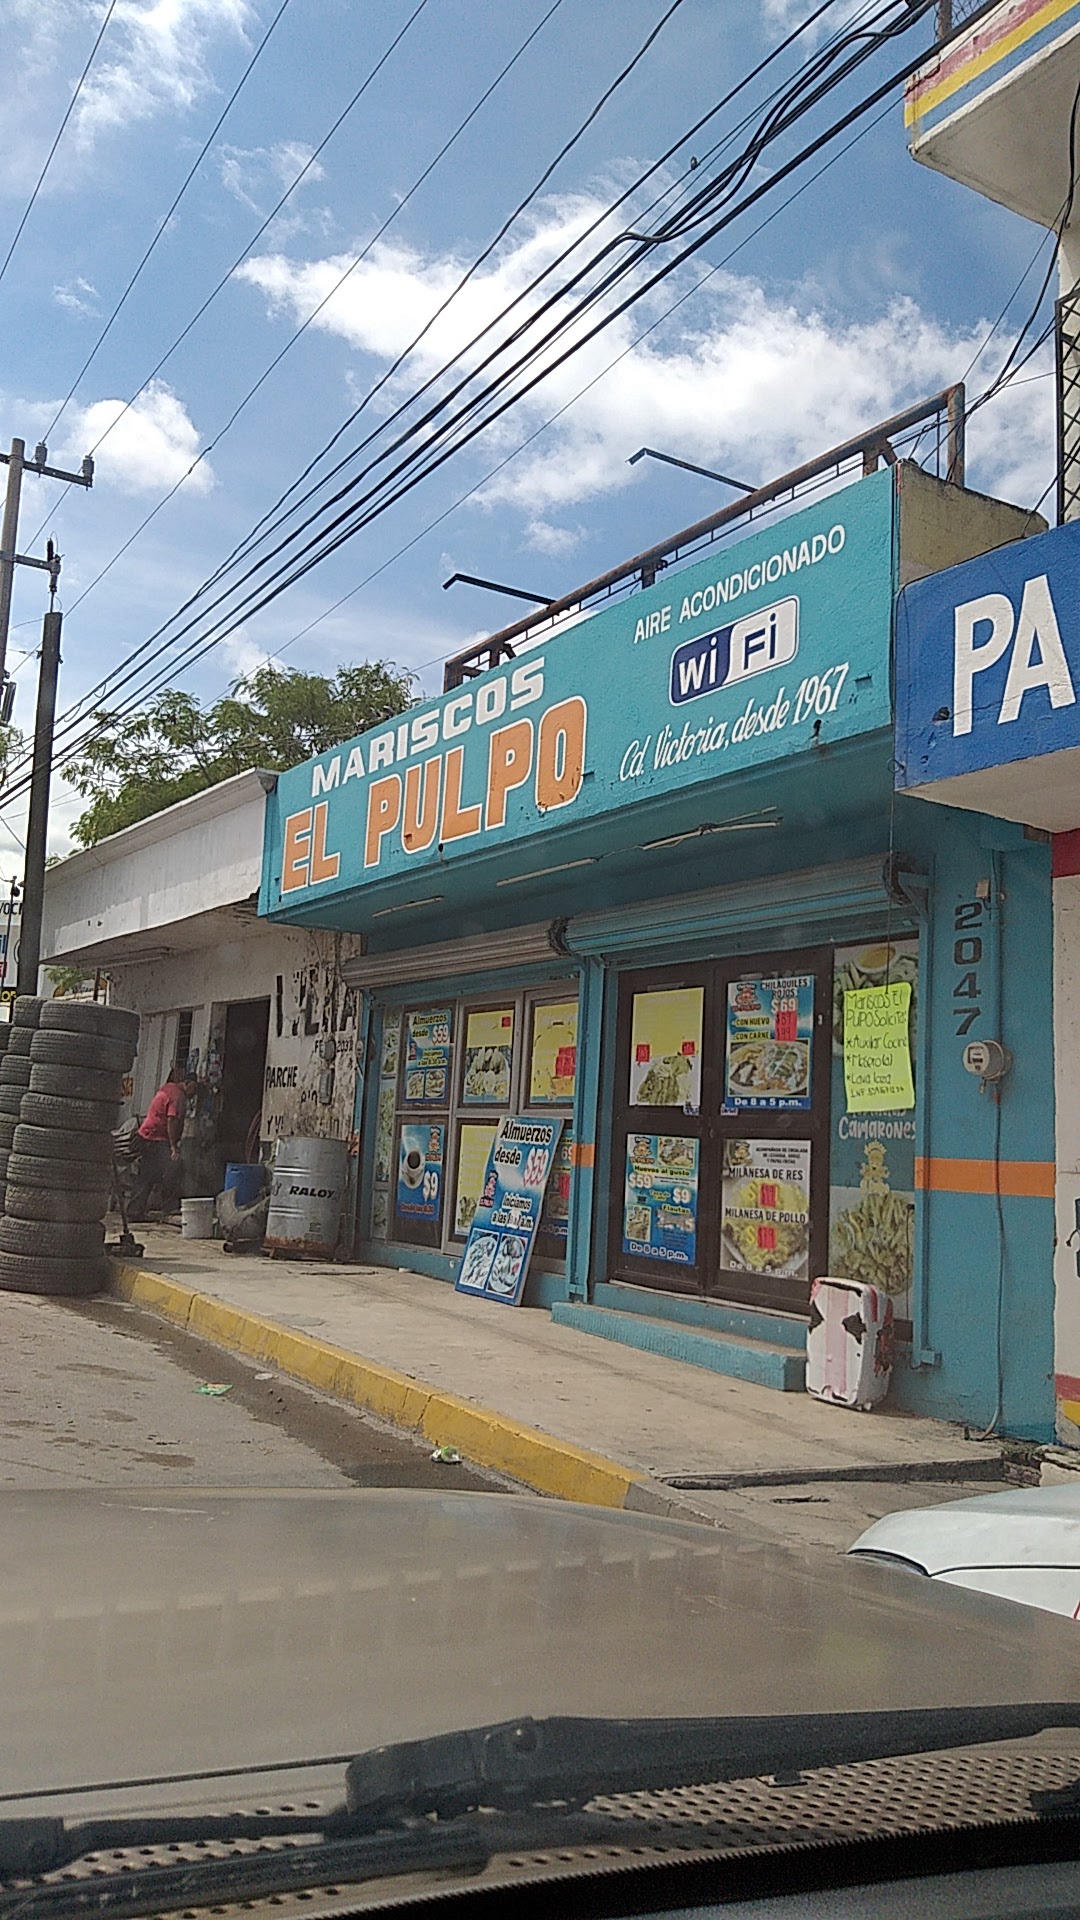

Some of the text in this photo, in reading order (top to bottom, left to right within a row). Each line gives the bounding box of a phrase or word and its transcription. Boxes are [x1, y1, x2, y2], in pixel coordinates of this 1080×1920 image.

[633, 524, 847, 644] AIRE ACONDICIONADO
[953, 574, 1076, 738] PA
[311, 656, 545, 797] MARISCOS
[619, 735, 652, 782] Cd.
[731, 686, 792, 744] desde
[792, 662, 850, 726] 1967
[281, 695, 588, 895] EL PULPO
[952, 902, 983, 1037] 2047
[760, 978, 808, 990] CHILAQUILES
[412, 1013, 447, 1026] Almuerzos
[411, 1028, 429, 1038] desde
[265, 1065, 299, 1093] PARCHE
[734, 1097, 748, 1106] De
[750, 1097, 757, 1106] 8
[769, 1098, 776, 1106] 5
[501, 1120, 554, 1144] Almuerzos
[494, 1146, 522, 1166] desde
[629, 1173, 653, 1189] $59
[728, 1167, 804, 1181] MILANESA DE RES
[289, 1185, 336, 1199] RALOY
[423, 1171, 439, 1202] $9
[673, 1186, 691, 1204] $9
[725, 1206, 806, 1224] MILANESA DE POLLO
[631, 1242, 643, 1253] De
[729, 1260, 743, 1270] De
